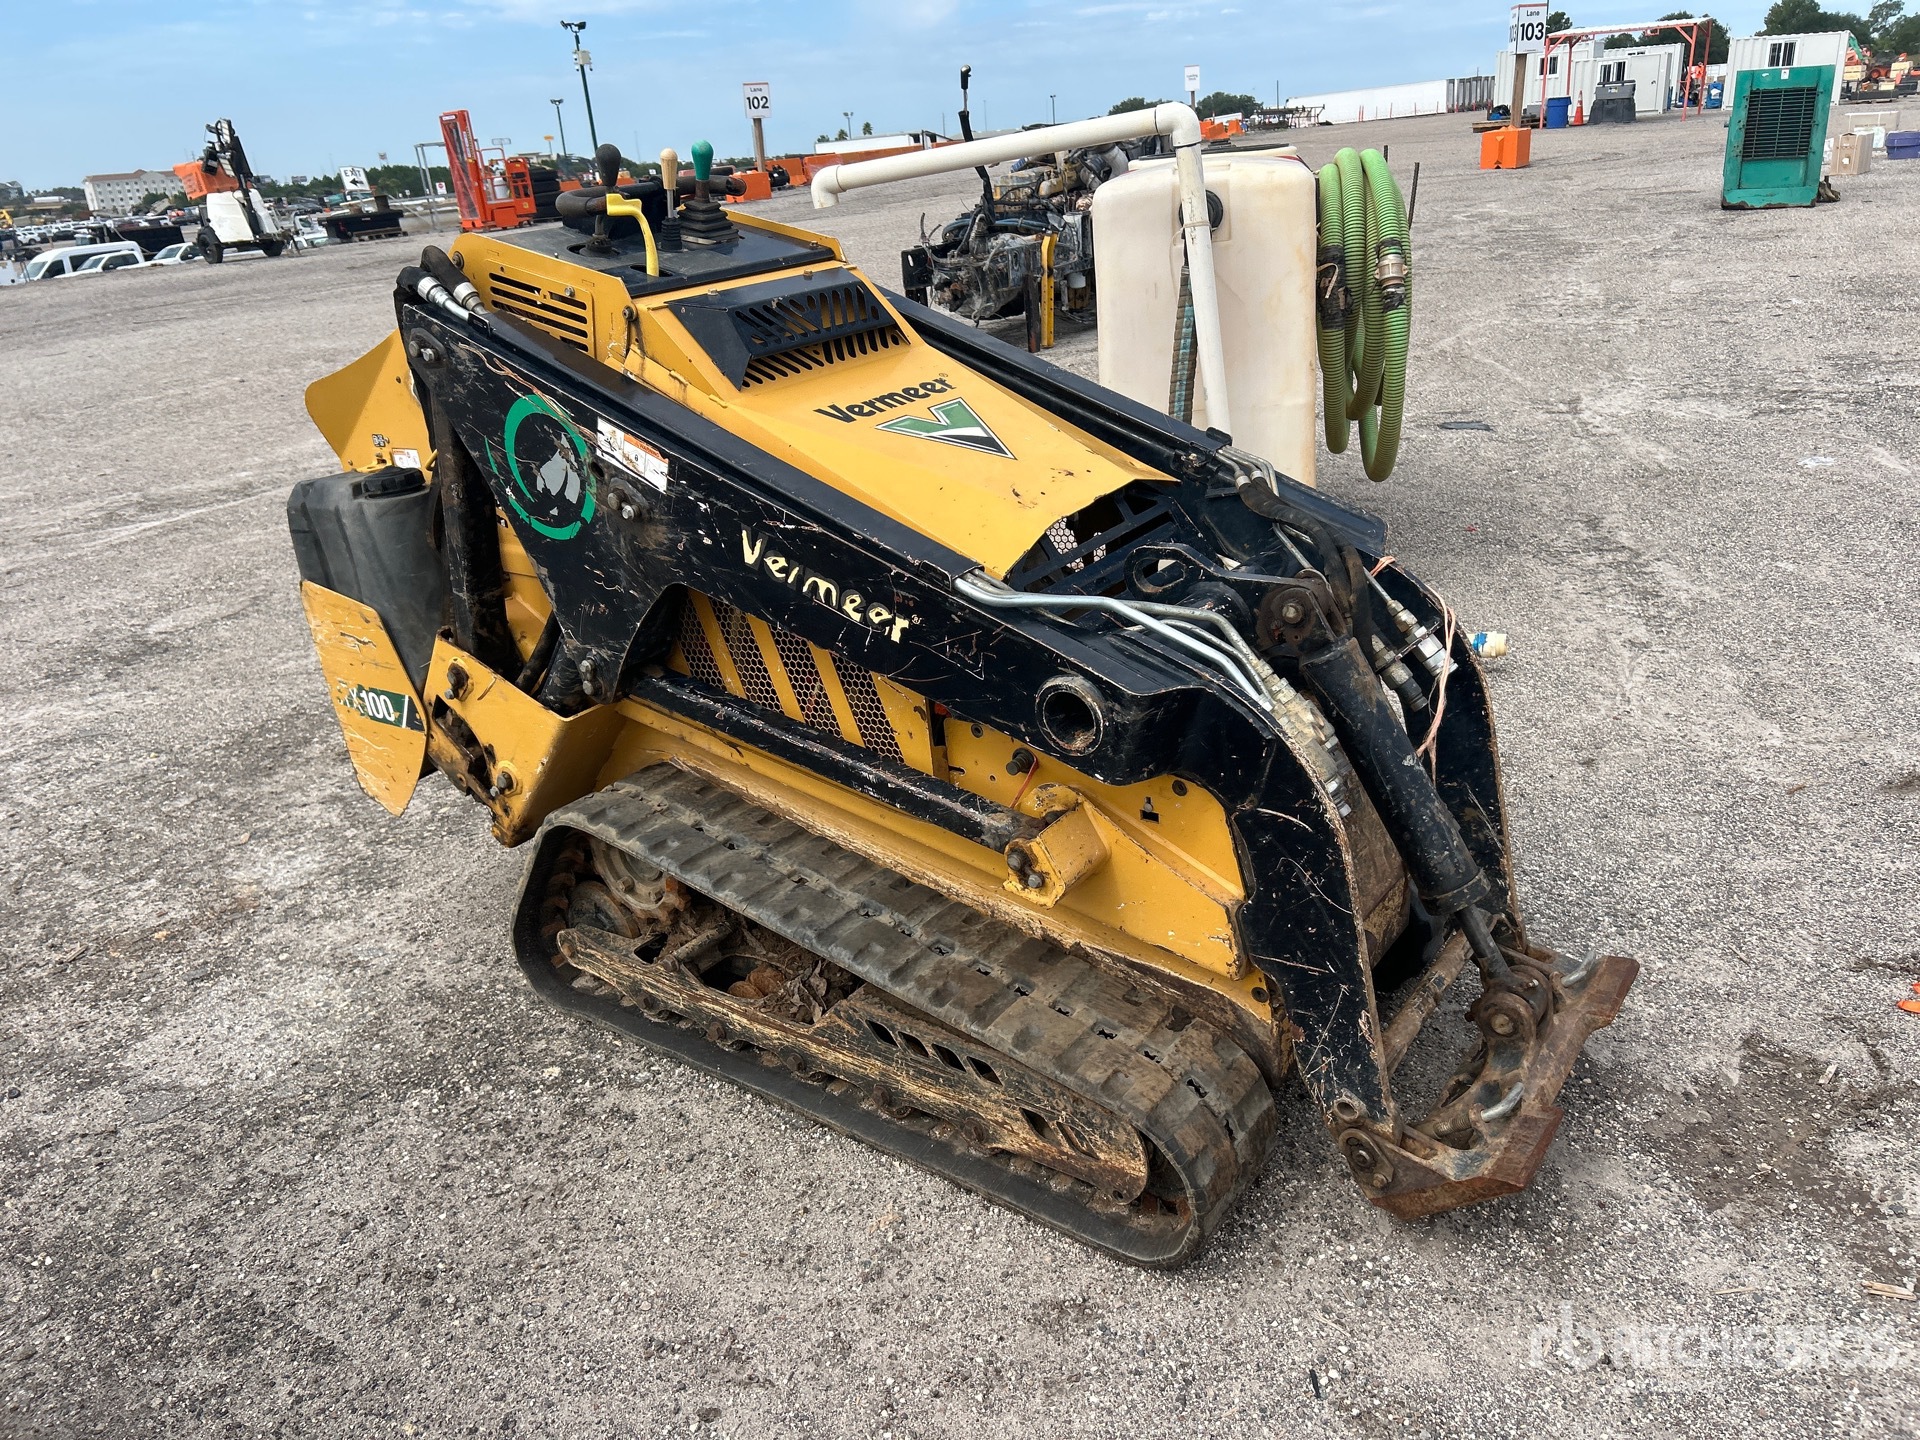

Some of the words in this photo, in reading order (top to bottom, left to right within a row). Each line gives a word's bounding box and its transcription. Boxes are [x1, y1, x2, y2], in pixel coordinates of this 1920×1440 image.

[1520, 22, 1545, 41] 103
[746, 95, 770, 110] 102
[343, 169, 362, 178] EXIT
